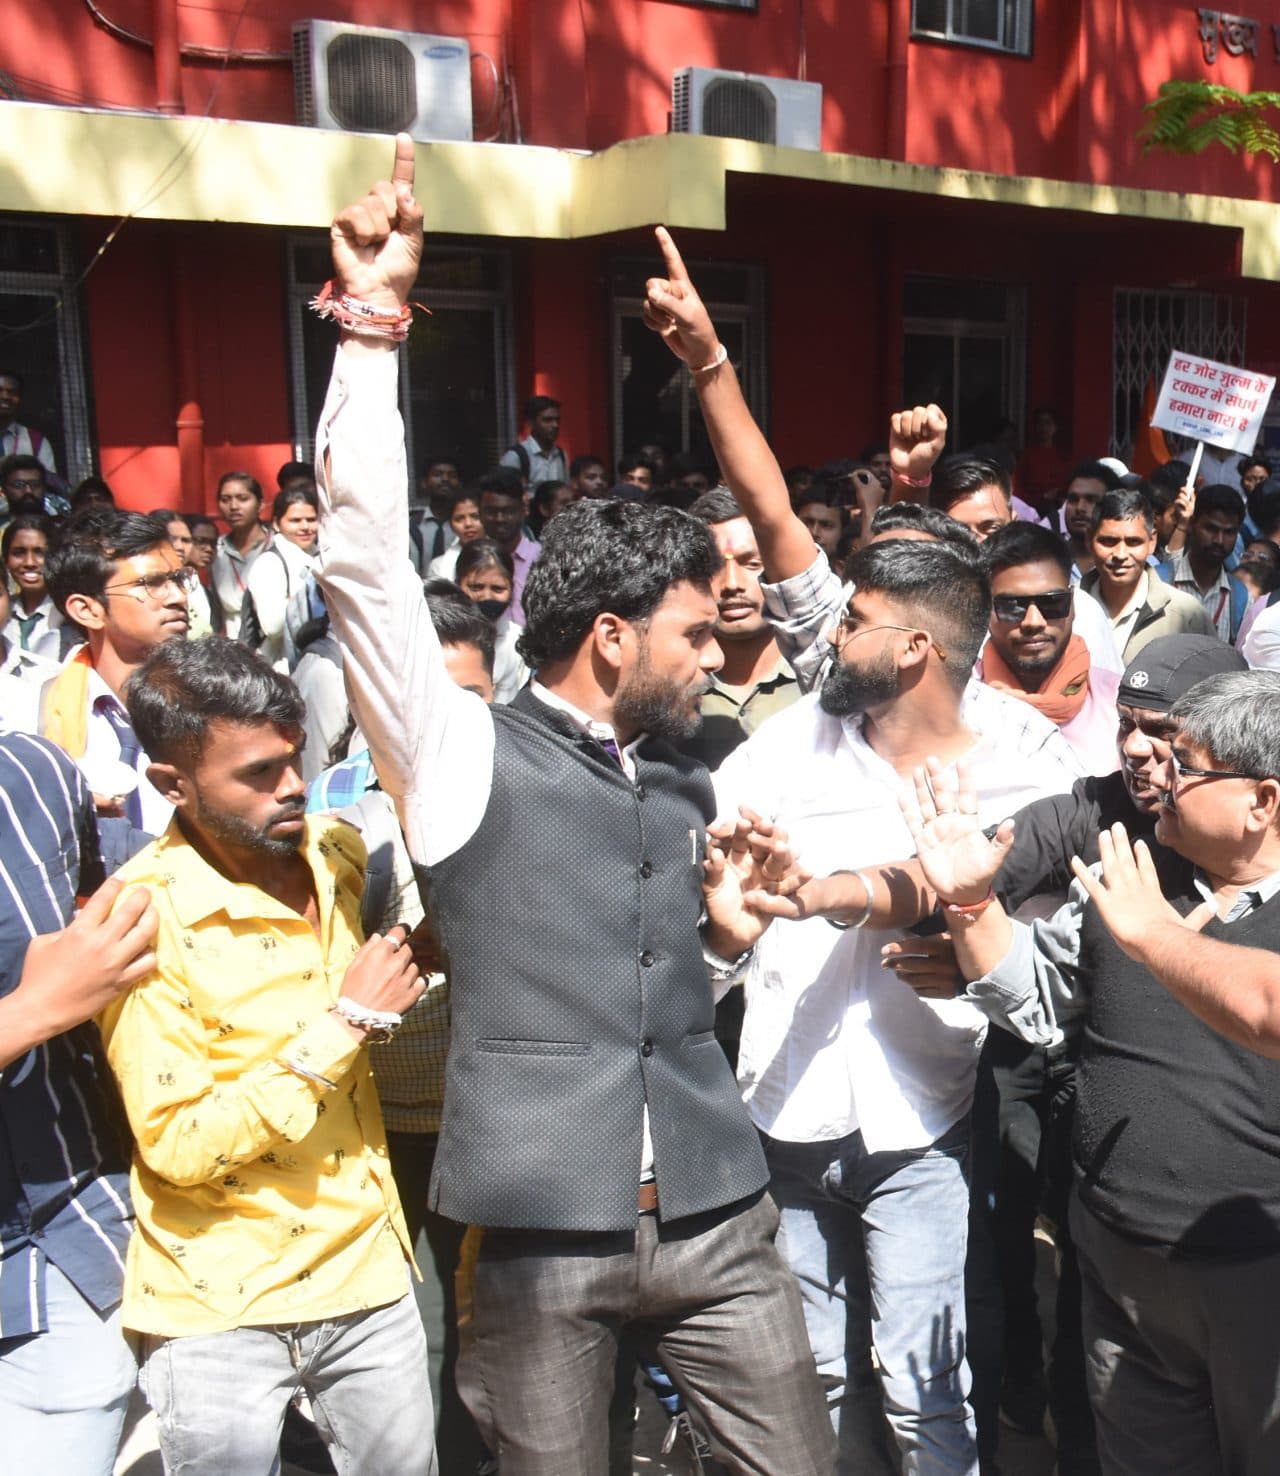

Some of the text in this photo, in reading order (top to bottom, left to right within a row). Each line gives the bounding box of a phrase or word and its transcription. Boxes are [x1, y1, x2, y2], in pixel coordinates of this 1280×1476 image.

[1198, 8, 1259, 64] मुख्य
[1172, 378, 1208, 398] टक्कर
[1210, 388, 1224, 403] में
[1174, 357, 1268, 393] हर जोर जुल्म के
[1168, 398, 1206, 419] हमारा
[1207, 409, 1236, 429] नारा
[1238, 417, 1249, 432] है
